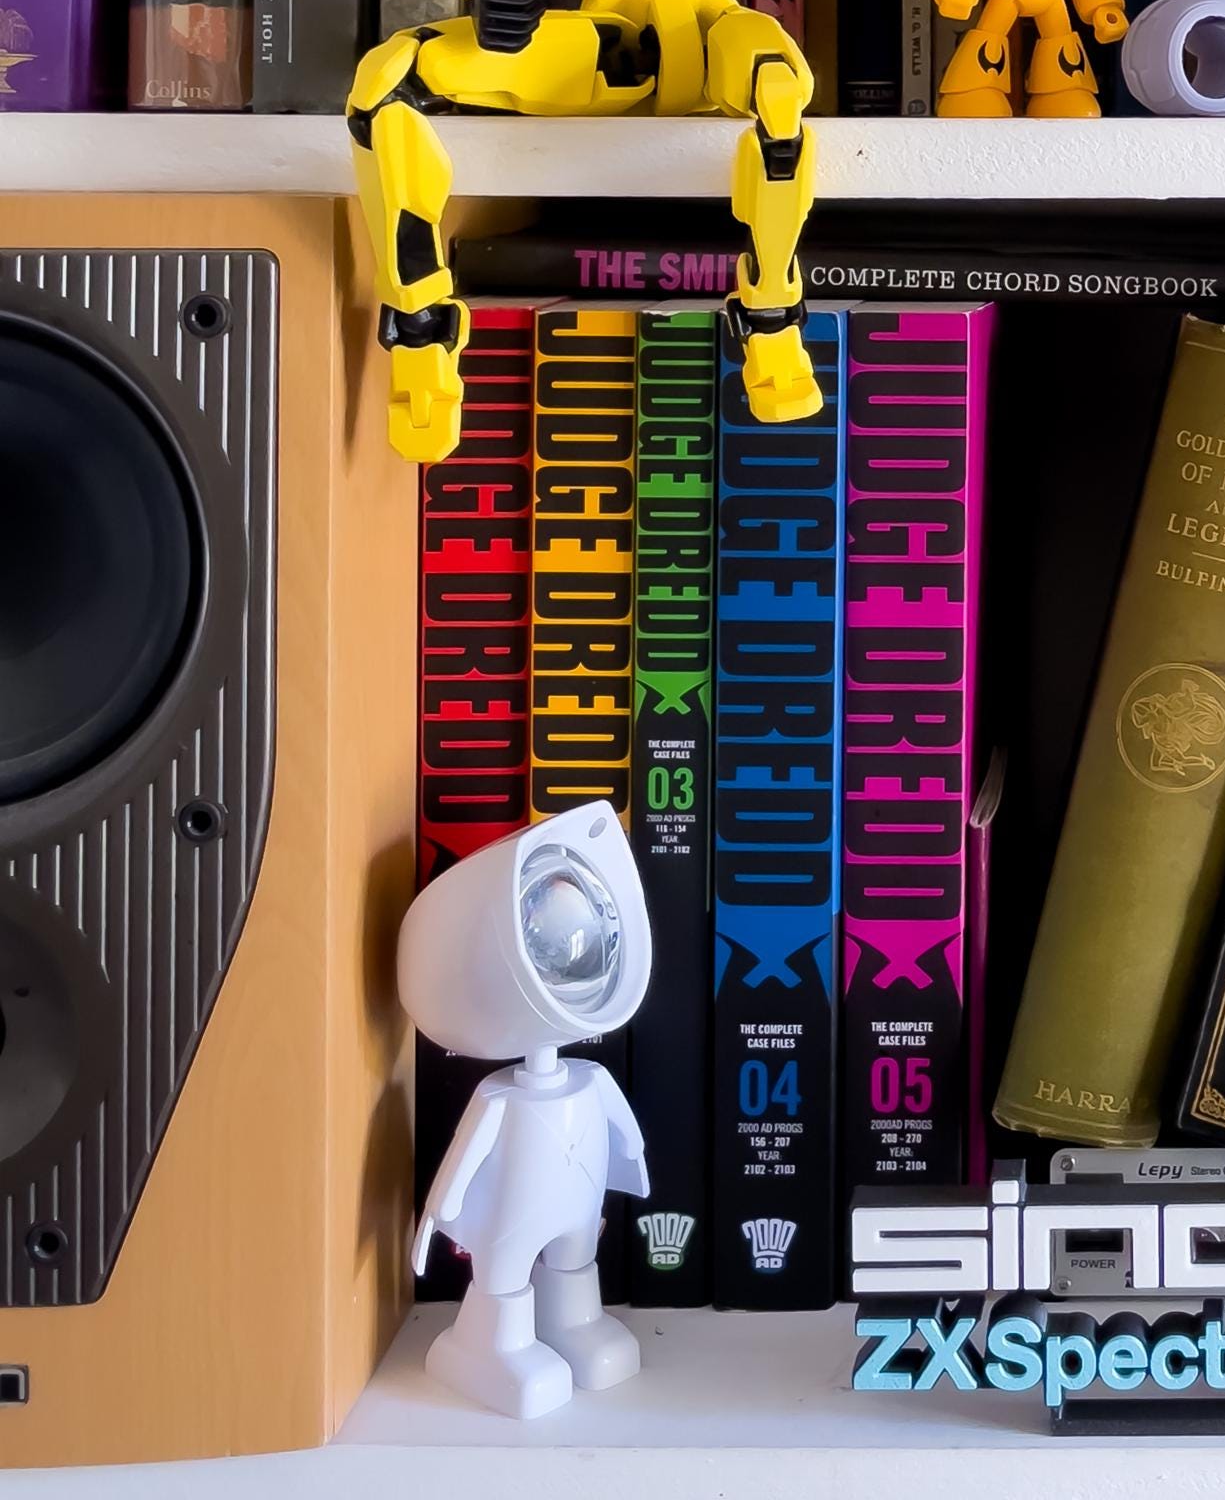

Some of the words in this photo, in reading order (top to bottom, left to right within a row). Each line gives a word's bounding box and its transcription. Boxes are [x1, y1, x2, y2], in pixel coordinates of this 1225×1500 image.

[261, 14, 274, 64] HOLT
[574, 249, 647, 289] THE
[658, 252, 740, 292] SMI
[810, 266, 956, 289] COMPLETE
[966, 269, 1061, 293] CHORD
[1067, 273, 1218, 298] SONGBOOK
[533, 312, 636, 551] JUDGE
[847, 312, 968, 603] JUDGE
[1181, 462, 1212, 485] OF
[531, 572, 632, 815] DREDD
[647, 766, 695, 810] 03
[845, 628, 966, 921] DREDD
[740, 1024, 756, 1035] THE
[758, 1024, 803, 1035] COMPLETE
[747, 1038, 769, 1048] CASE
[771, 1038, 796, 1048] FILES
[739, 1059, 801, 1116] 04
[871, 1057, 933, 1114] 05
[1138, 1162, 1184, 1180] Lepy
[1191, 1166, 1221, 1176] Stereo
[1069, 1258, 1116, 1270] POWER
[853, 1317, 981, 1392] ZX
